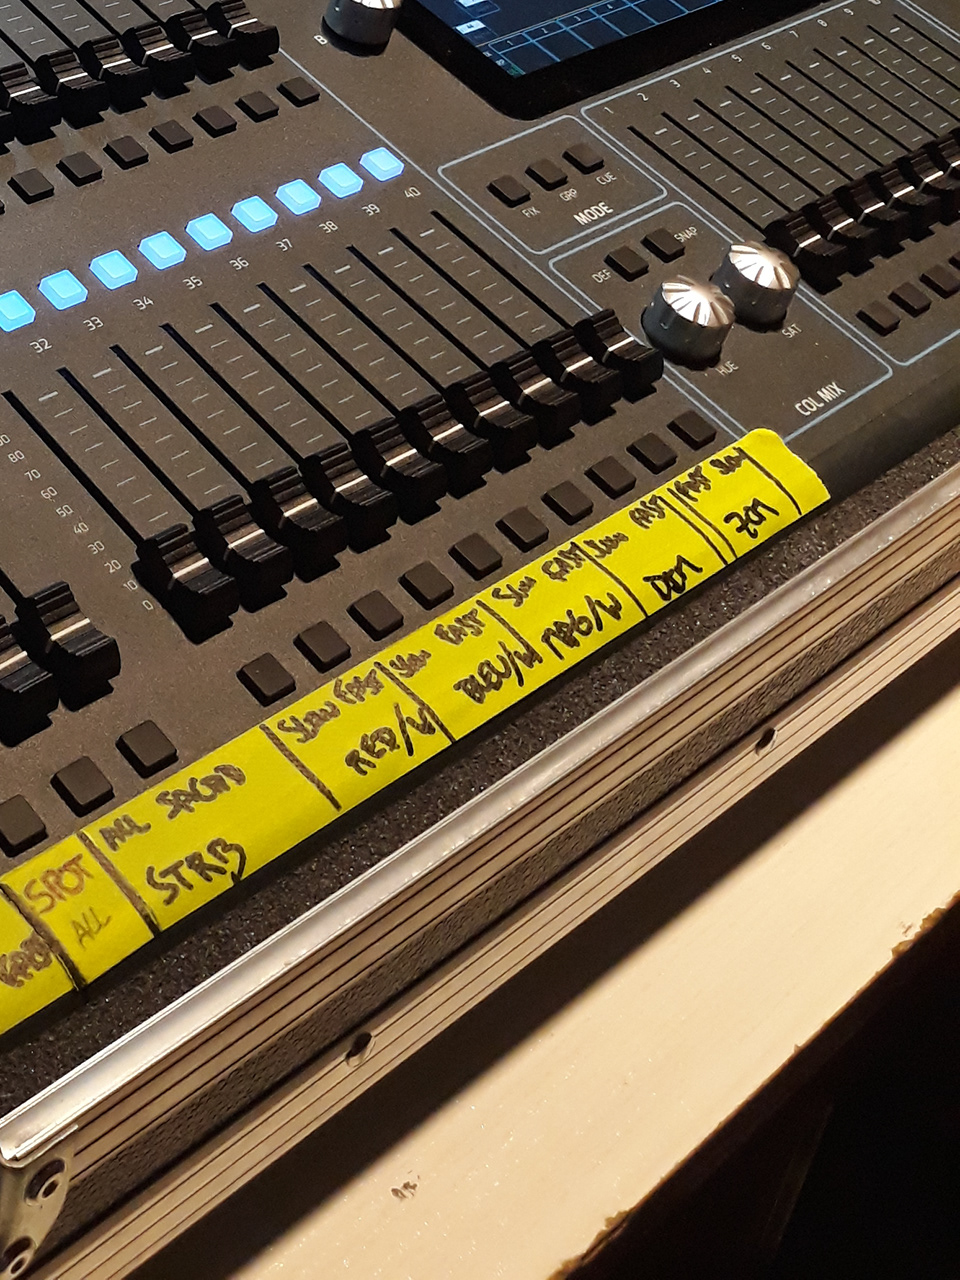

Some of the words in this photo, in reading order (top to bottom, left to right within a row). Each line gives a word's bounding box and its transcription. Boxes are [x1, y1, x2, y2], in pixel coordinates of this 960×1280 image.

[313, 34, 329, 46] B
[636, 92, 650, 101] 2
[669, 79, 681, 89] 3
[701, 66, 712, 75] 4
[730, 53, 743, 63] 5
[760, 41, 772, 51] 6
[789, 30, 800, 39] 7
[816, 19, 828, 27] 8
[843, 7, 854, 16] 9
[596, 171, 618, 186] CUE
[559, 188, 579, 202] GRP
[521, 206, 541, 219] FIX
[573, 201, 615, 226] MODE
[673, 226, 699, 243] SNAP
[29, 338, 54, 355] 32
[83, 316, 105, 332] 33
[132, 295, 155, 311] 34
[182, 275, 204, 291] 35
[229, 256, 251, 271] 36
[276, 238, 294, 253] 37
[319, 219, 340, 235] 38
[361, 202, 381, 218] 39
[403, 185, 422, 200] 40
[591, 269, 612, 284] DEF
[781, 323, 803, 339] SAT
[716, 360, 740, 377] HUE
[794, 397, 823, 417] COL
[819, 381, 848, 404] MIX
[7, 449, 26, 464] 80
[24, 468, 42, 482] 70
[40, 486, 59, 500] 60
[55, 503, 75, 518] 50
[73, 521, 90, 535] 40
[87, 540, 106, 555] 30
[104, 559, 122, 574] 20
[122, 580, 139, 592] 10
[141, 599, 155, 612] 0
[23, 852, 96, 915] SPOT
[71, 905, 112, 950] ALL
